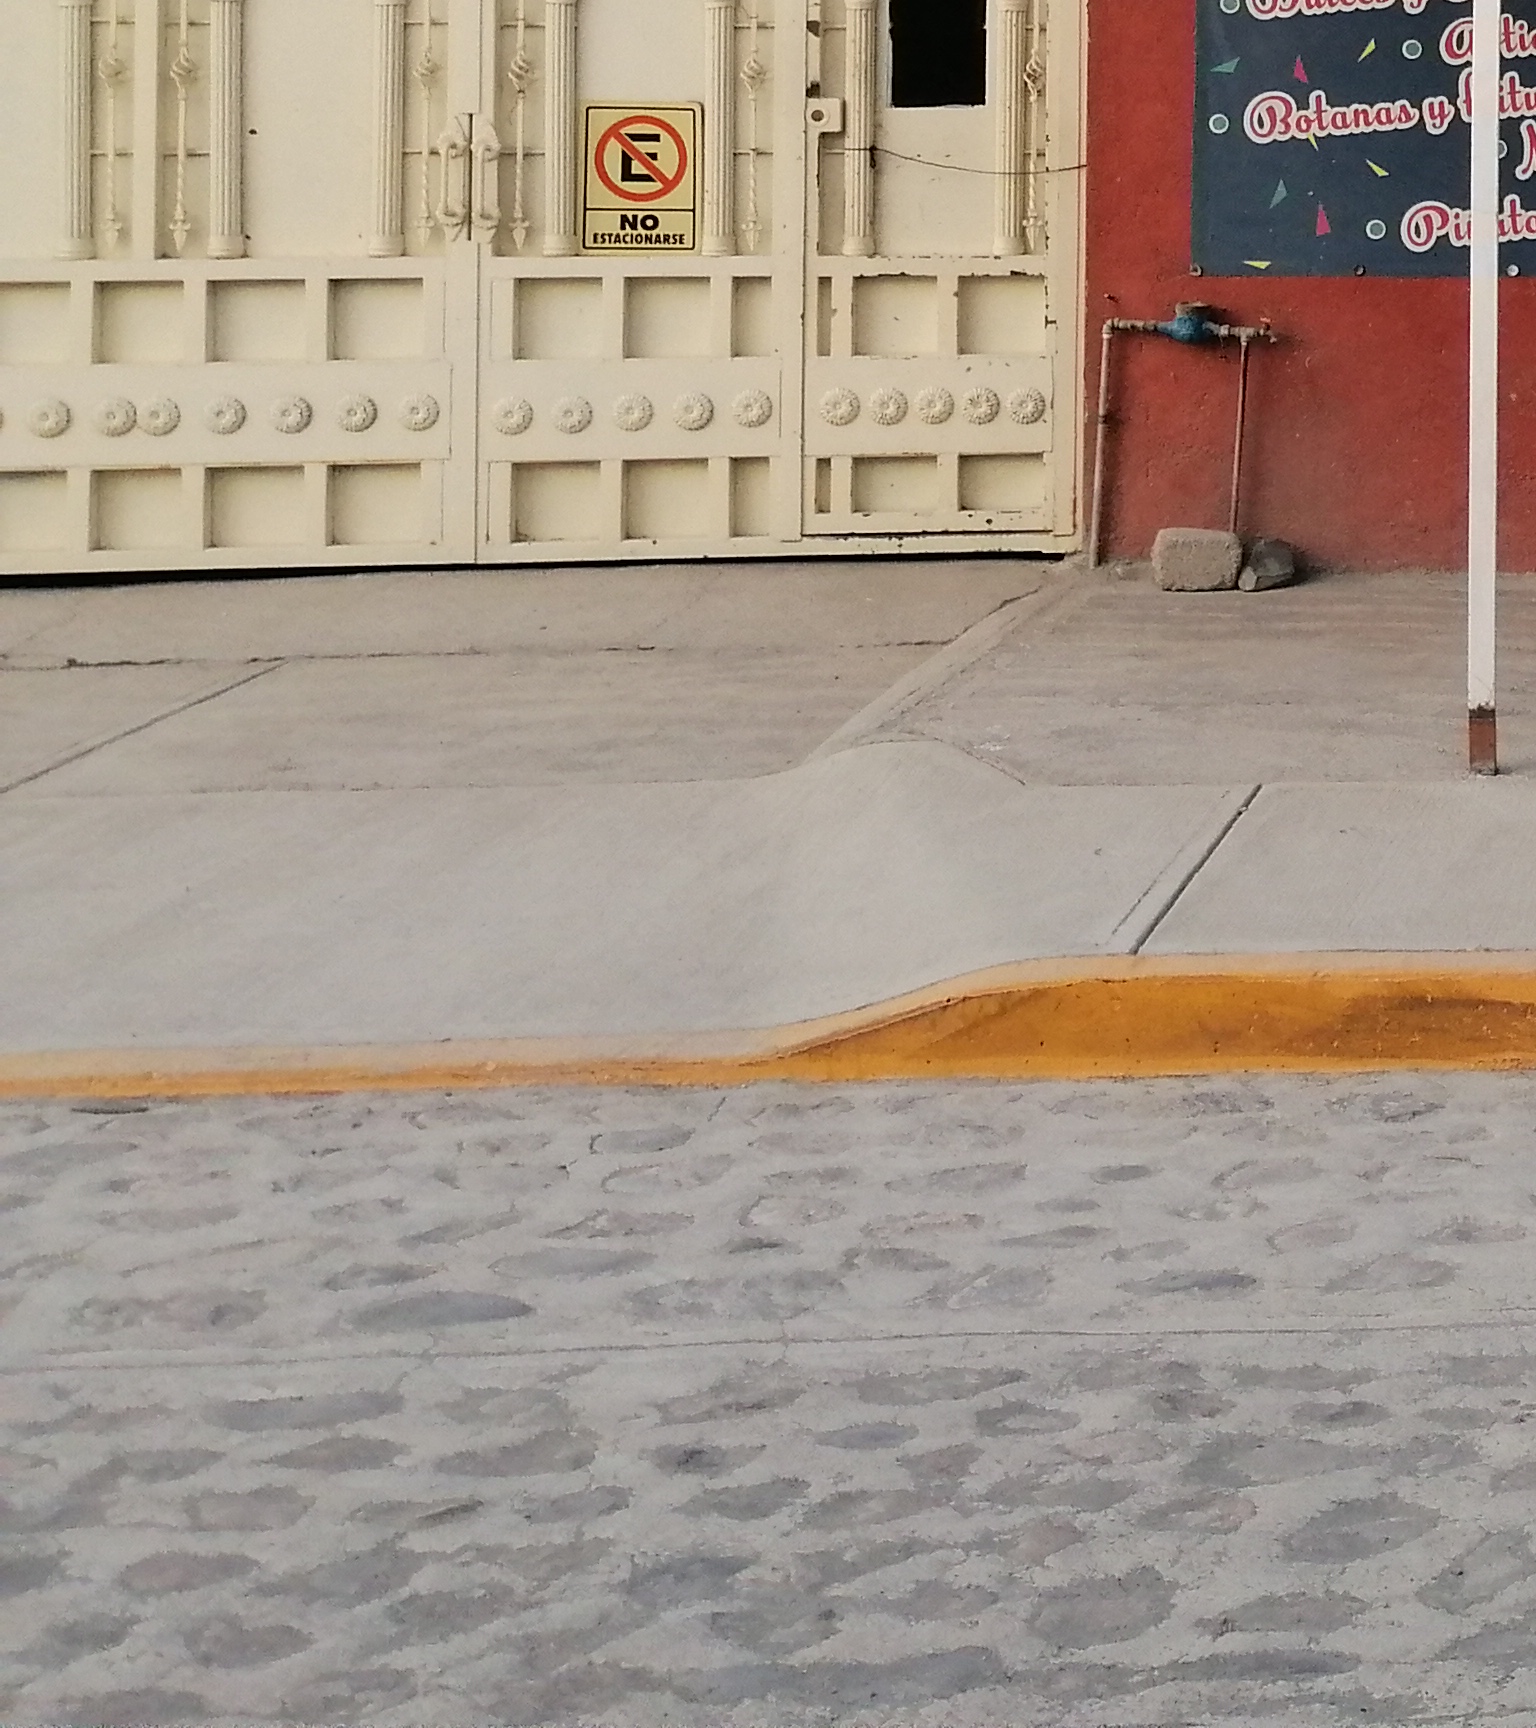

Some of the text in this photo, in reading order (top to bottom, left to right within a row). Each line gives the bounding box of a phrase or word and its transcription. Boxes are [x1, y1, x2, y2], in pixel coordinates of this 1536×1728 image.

[1246, 91, 1417, 142] Botanas
[1424, 97, 1452, 133] y
[619, 213, 660, 231] NO
[592, 232, 686, 246] ESTACIONARSE
